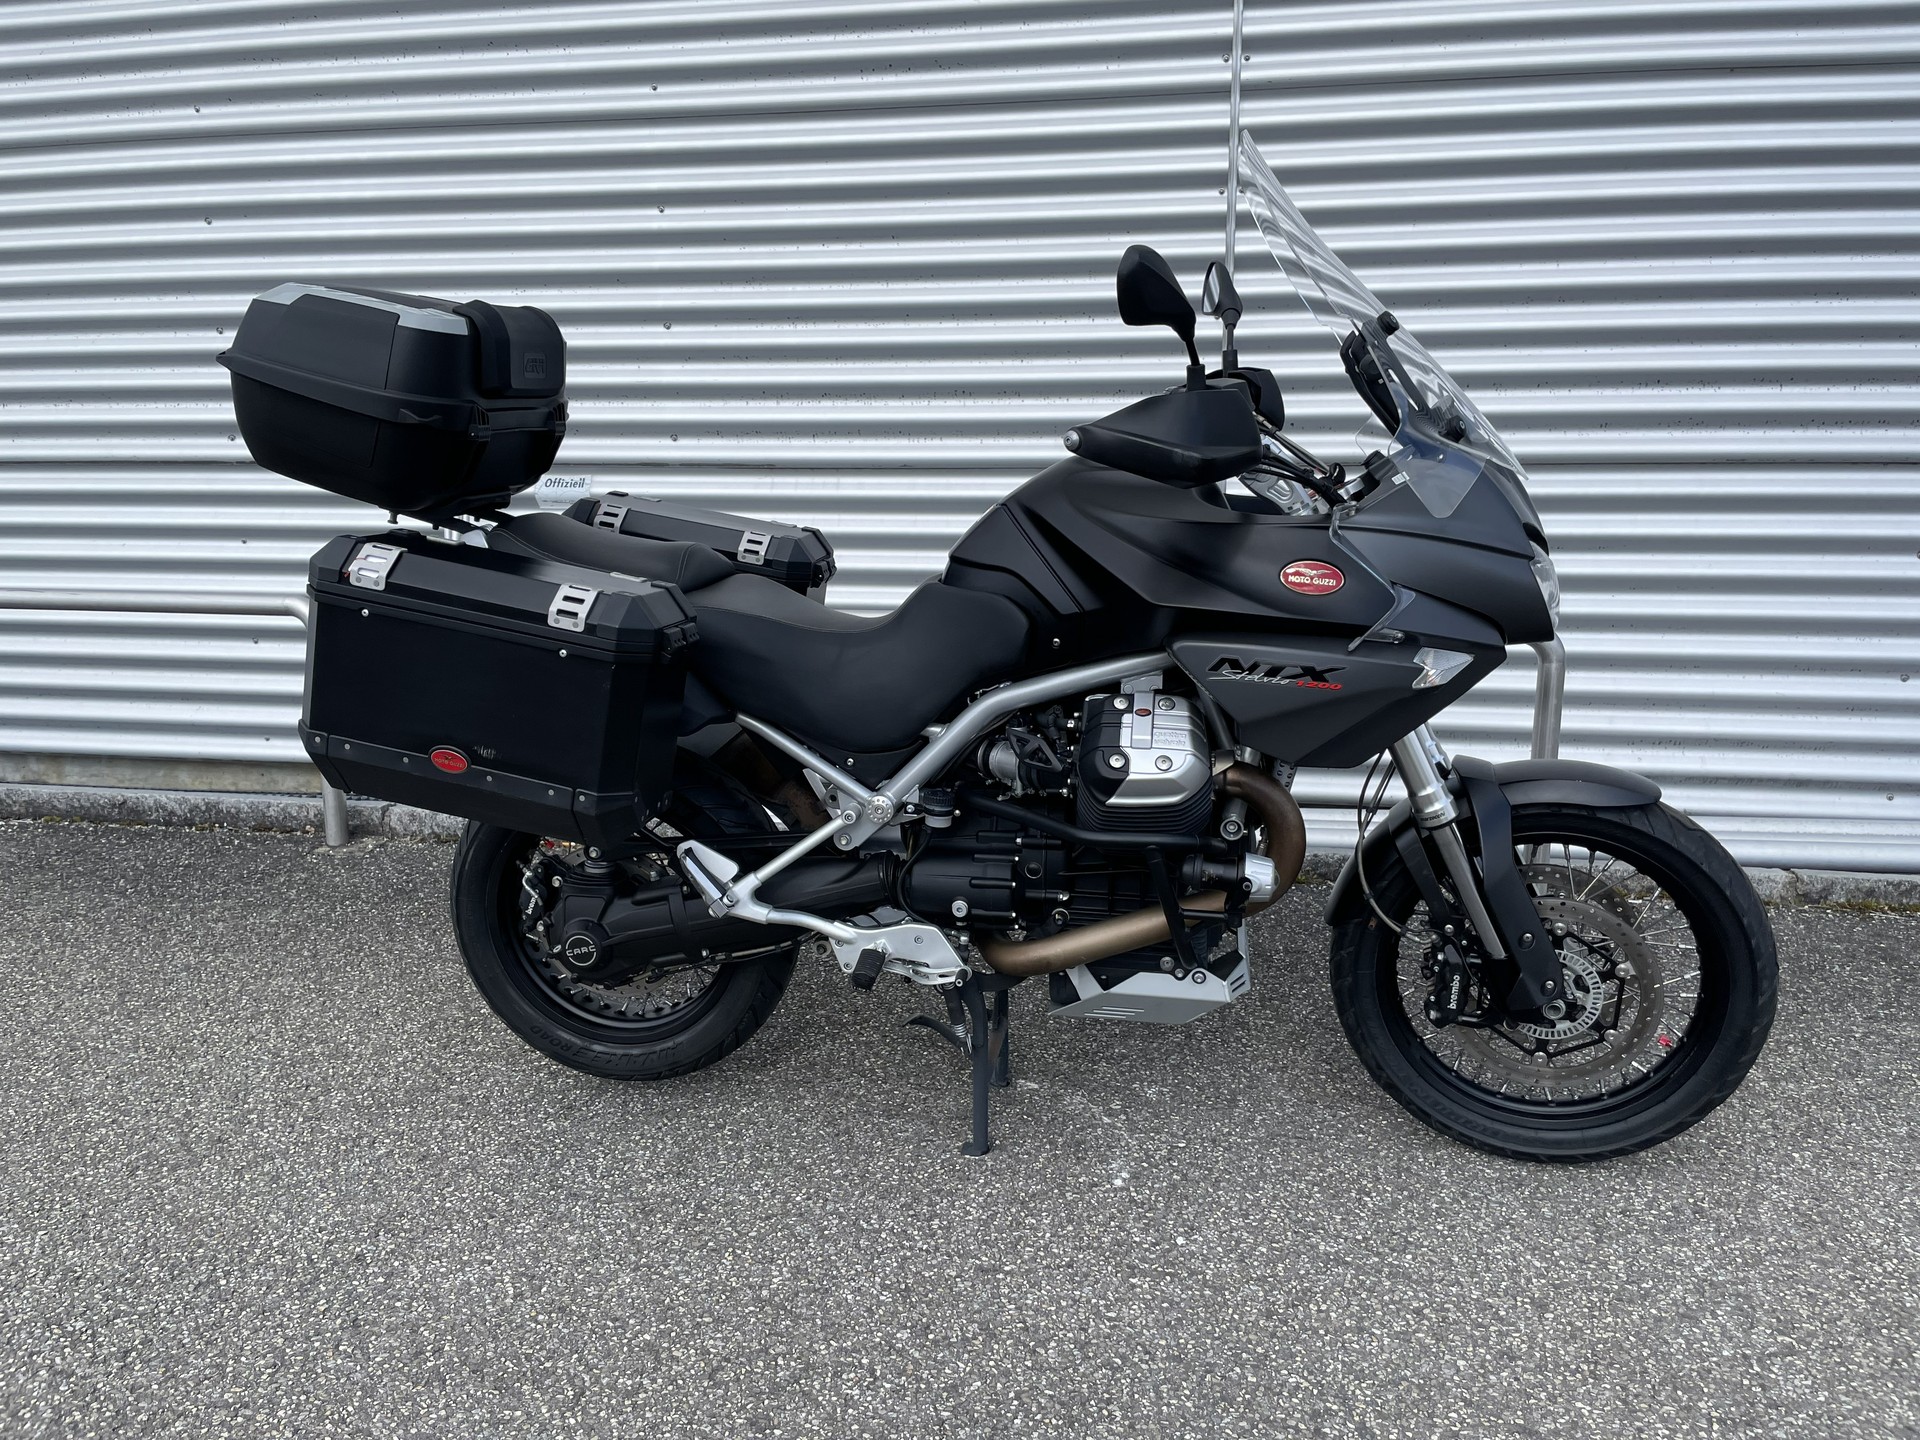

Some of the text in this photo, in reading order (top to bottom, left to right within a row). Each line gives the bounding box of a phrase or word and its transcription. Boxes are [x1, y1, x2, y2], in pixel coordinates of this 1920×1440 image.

[1287, 574, 1336, 586] MOTO GUZZI
[1206, 654, 1348, 683] NTX
[1208, 669, 1342, 690] Stelvio 1200
[566, 945, 597, 957] CARC
[1447, 974, 1460, 1010] brembo
[529, 1024, 573, 1053] ROAD
